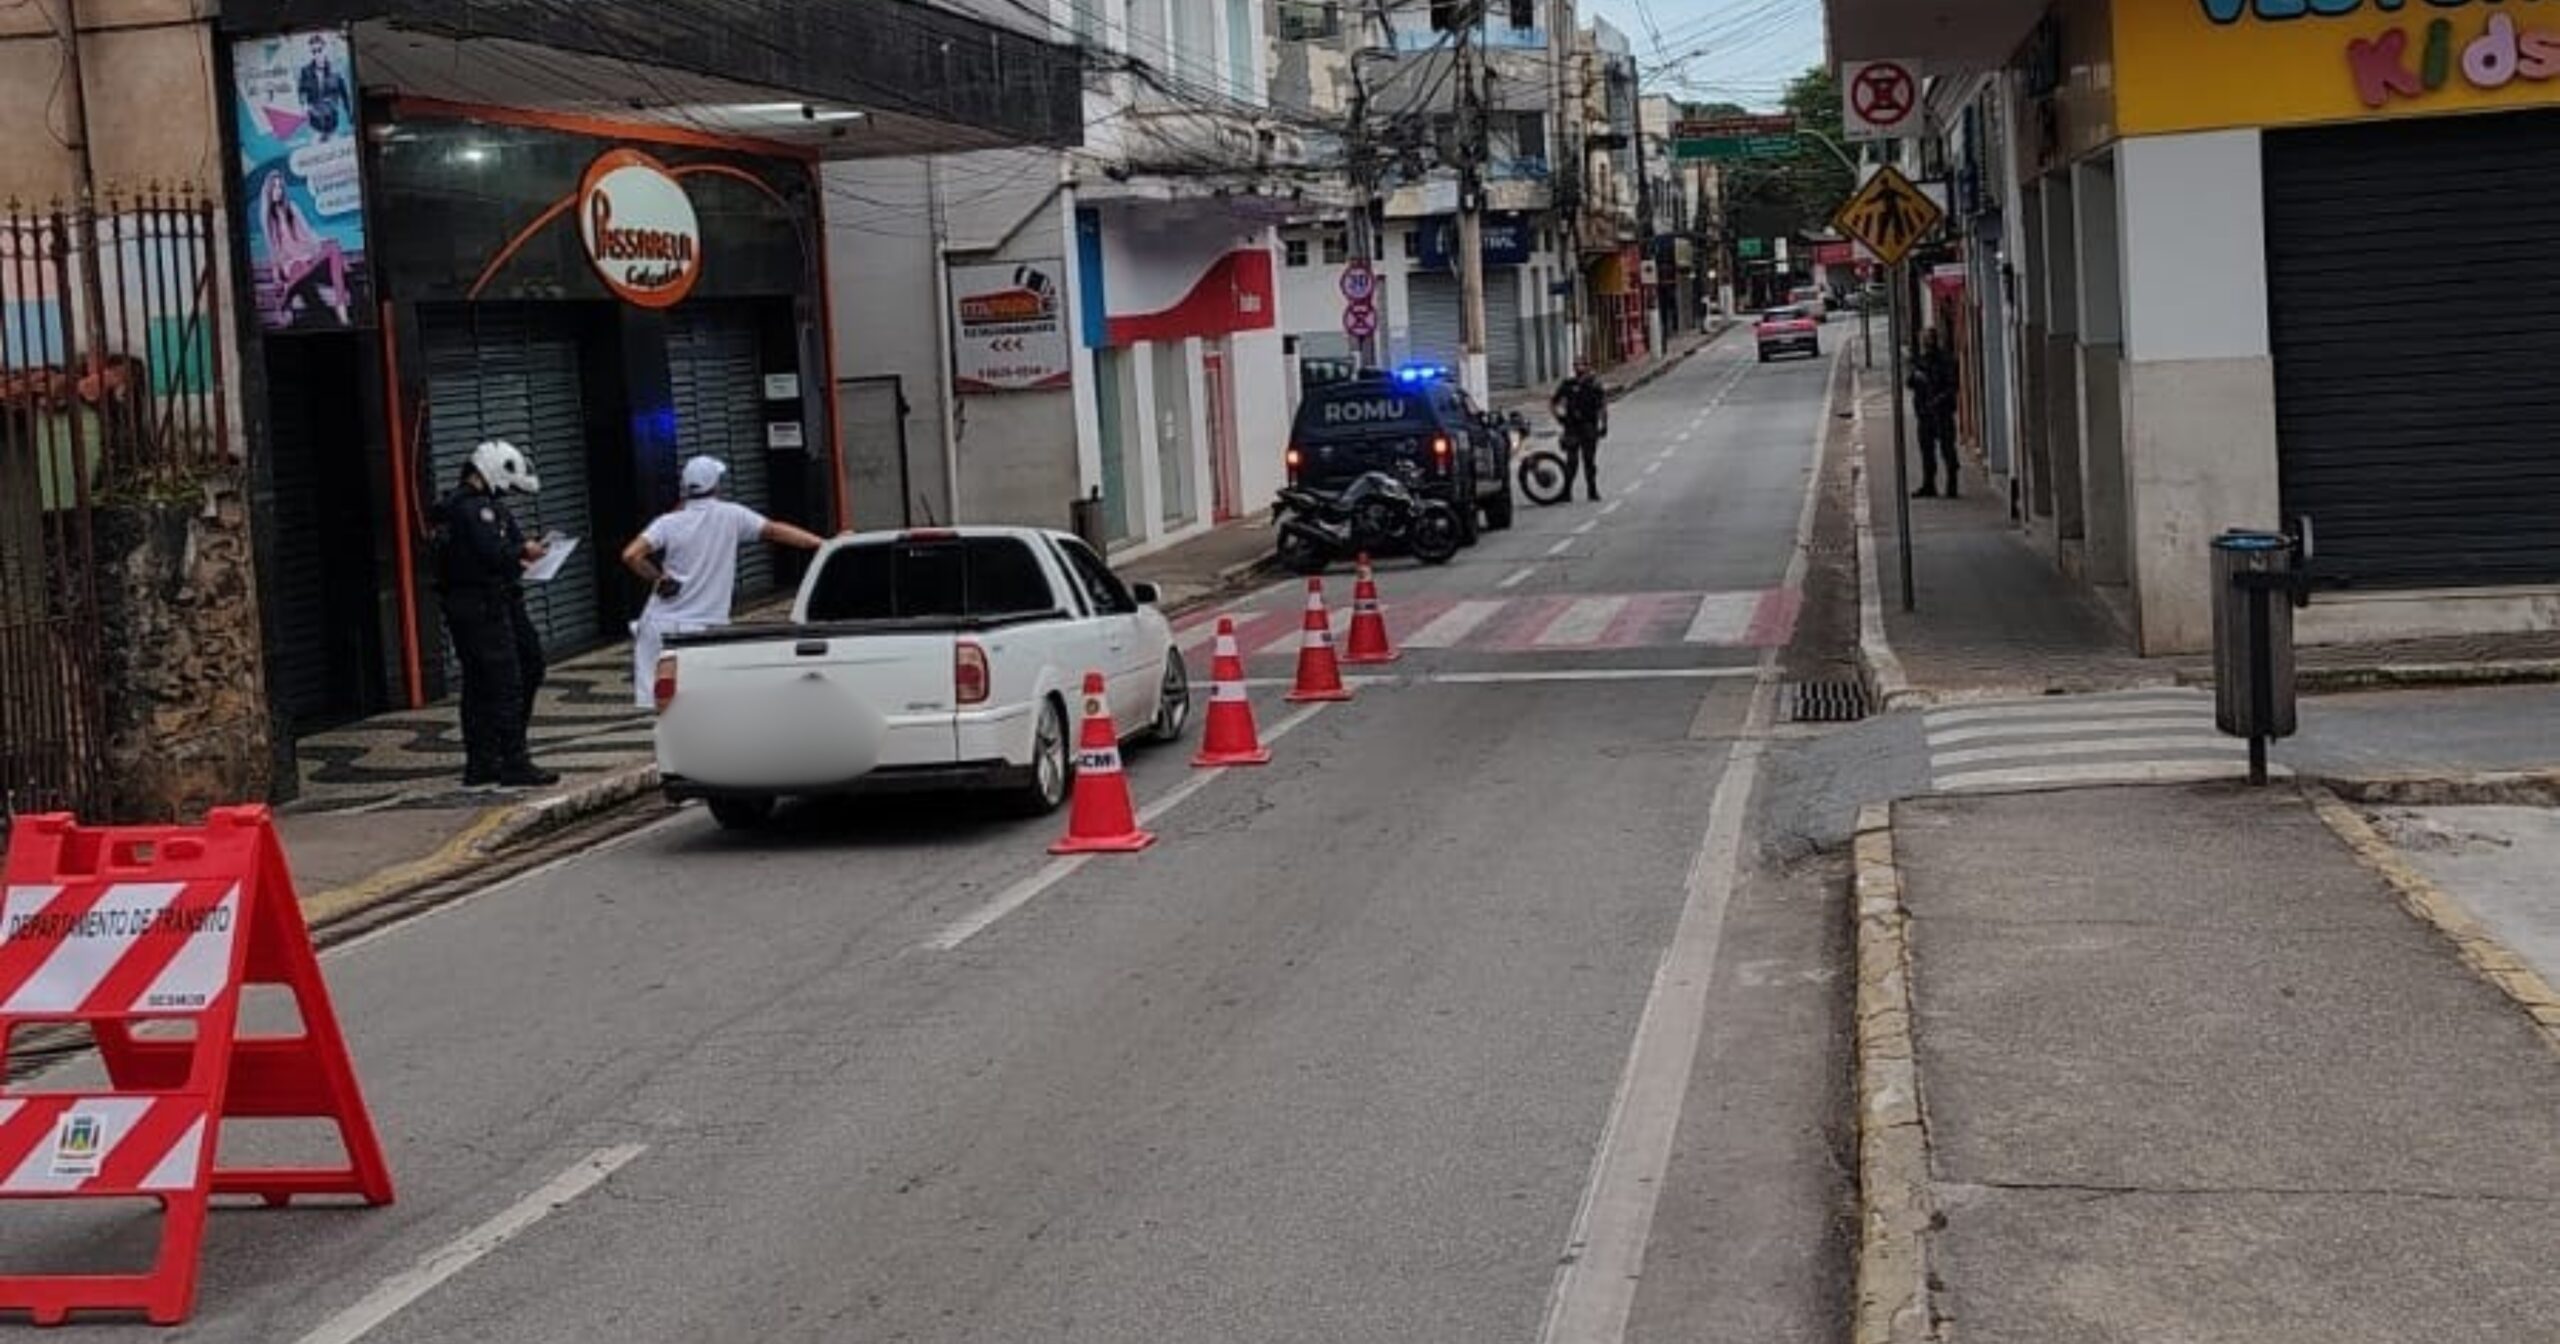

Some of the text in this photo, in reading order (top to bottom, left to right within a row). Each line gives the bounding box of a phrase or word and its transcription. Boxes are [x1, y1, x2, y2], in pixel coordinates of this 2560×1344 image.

[2345, 11, 2560, 108] Kids
[1325, 399, 1404, 422] ROMU
[8, 909, 129, 939] DEPARTAMENTO
[130, 908, 152, 935] DE
